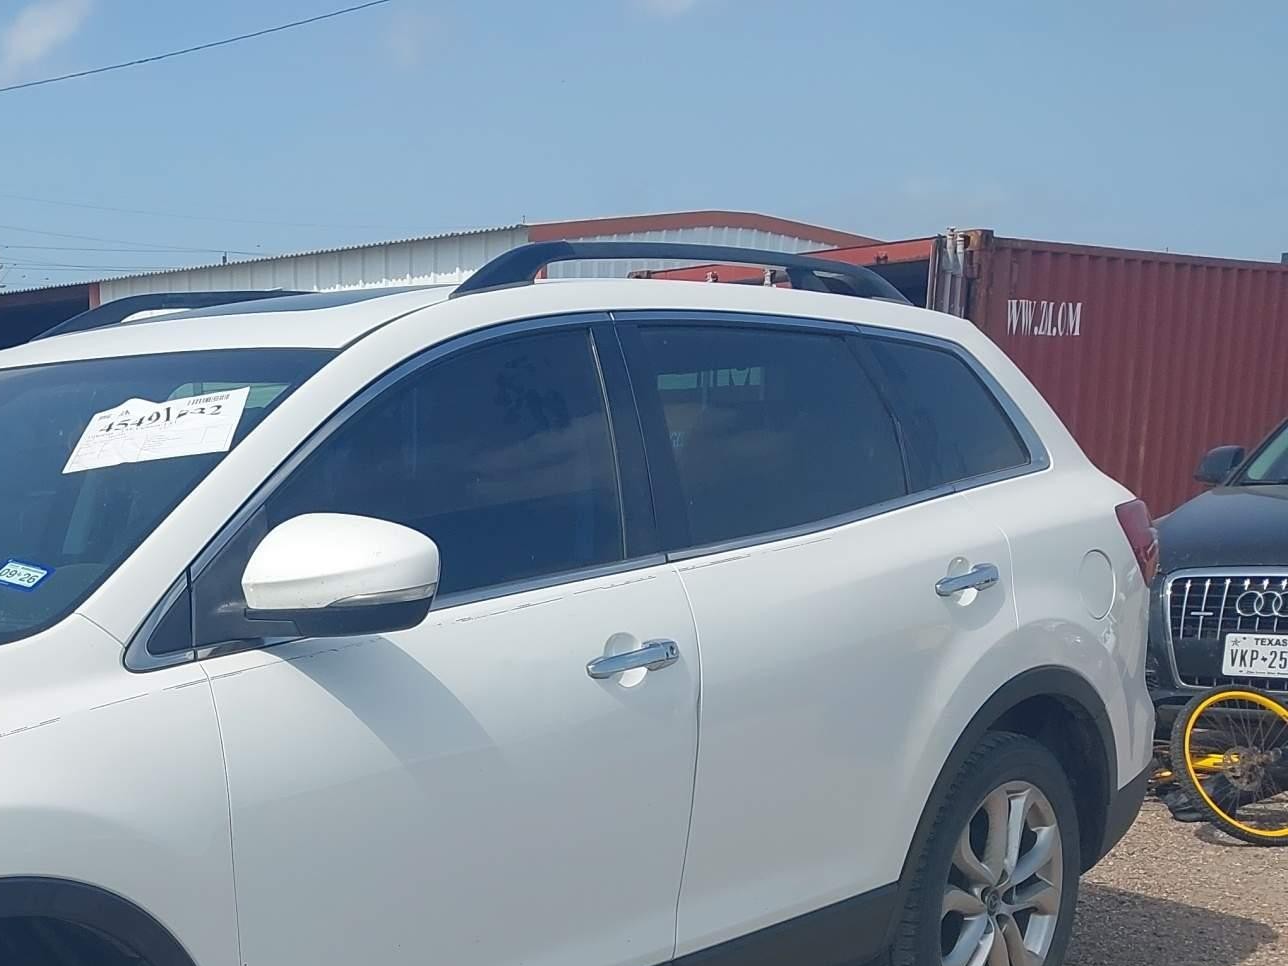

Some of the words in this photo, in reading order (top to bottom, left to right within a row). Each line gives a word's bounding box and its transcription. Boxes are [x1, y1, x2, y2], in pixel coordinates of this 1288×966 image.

[0, 568, 18, 578] 09
[19, 573, 39, 584] 26
[1254, 637, 1288, 647] TEXAS
